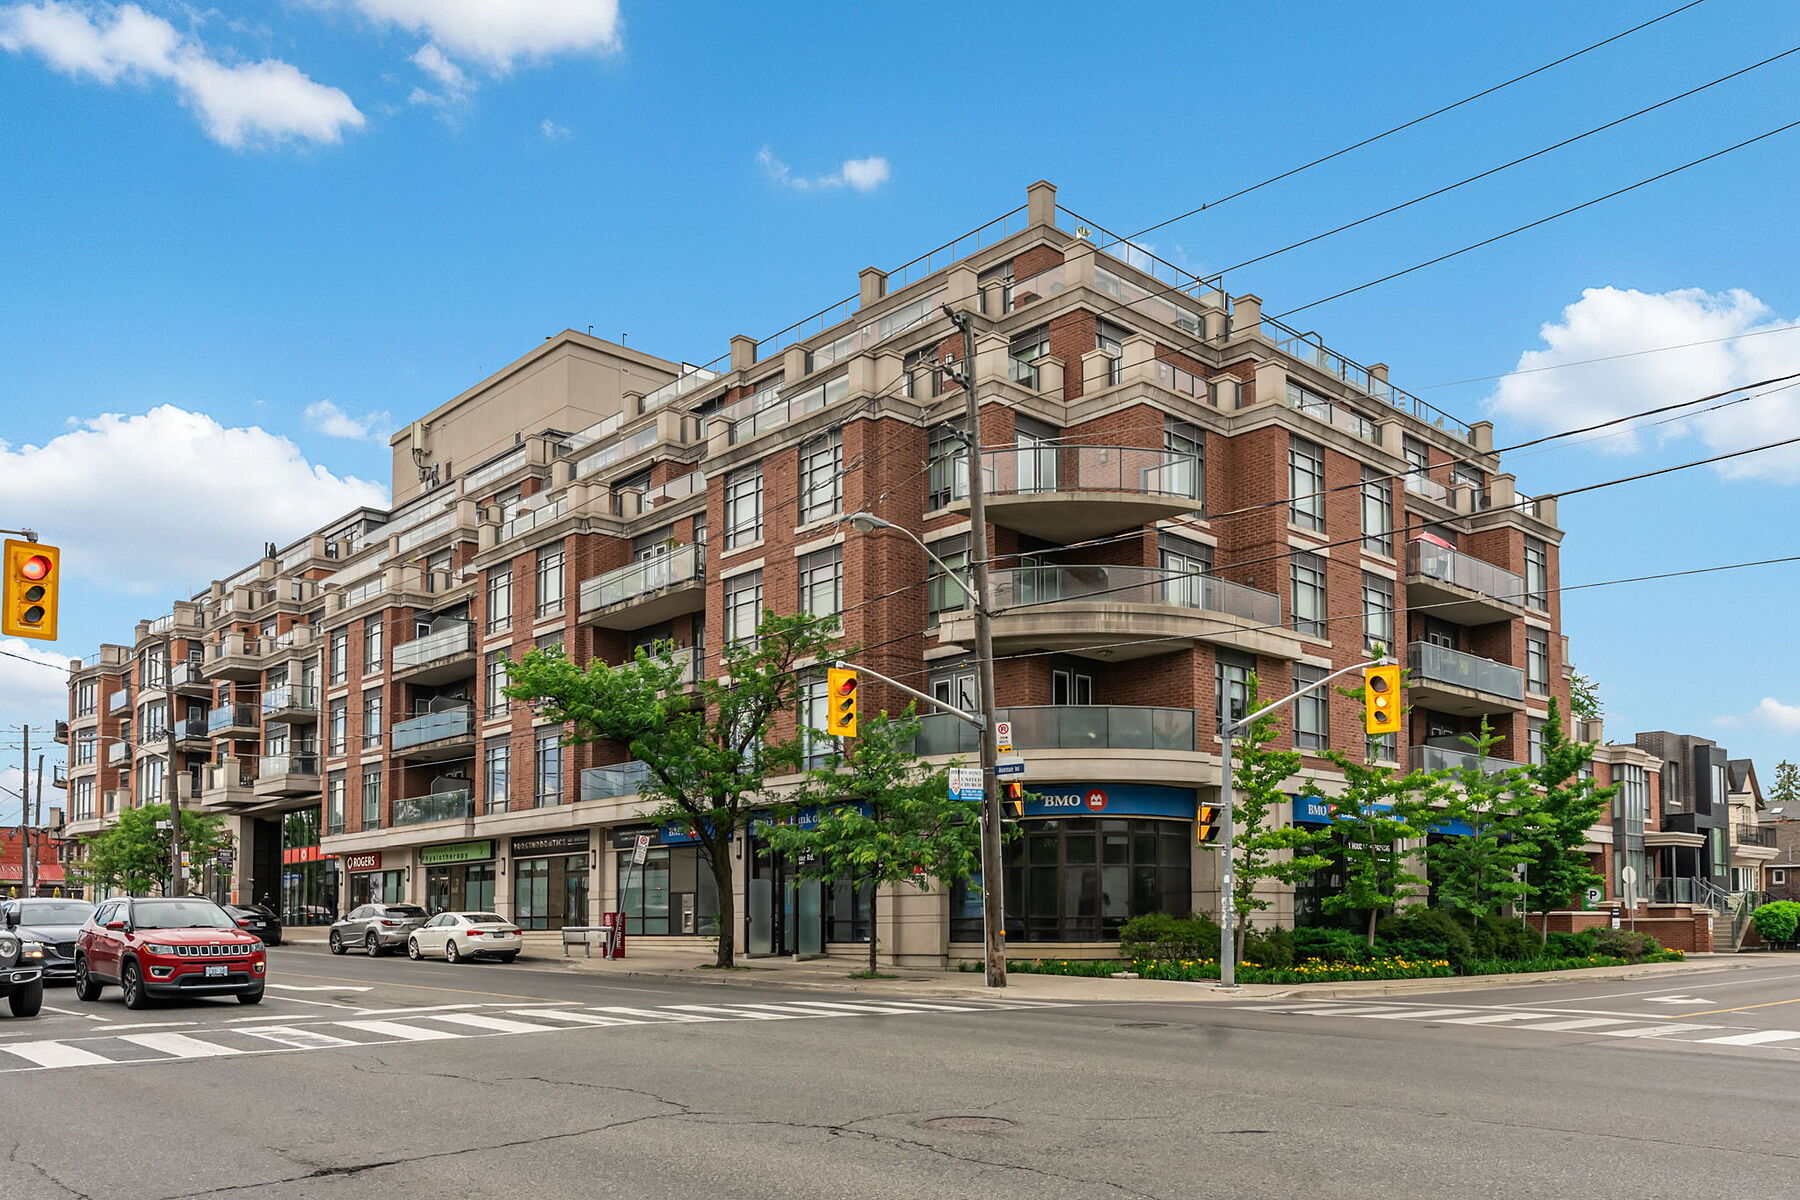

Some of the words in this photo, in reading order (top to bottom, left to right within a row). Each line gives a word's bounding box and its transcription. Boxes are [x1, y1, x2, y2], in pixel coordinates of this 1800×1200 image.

[1043, 794, 1081, 807] BMO
[1308, 804, 1327, 817] BMO
[353, 855, 376, 868] ROGERS
